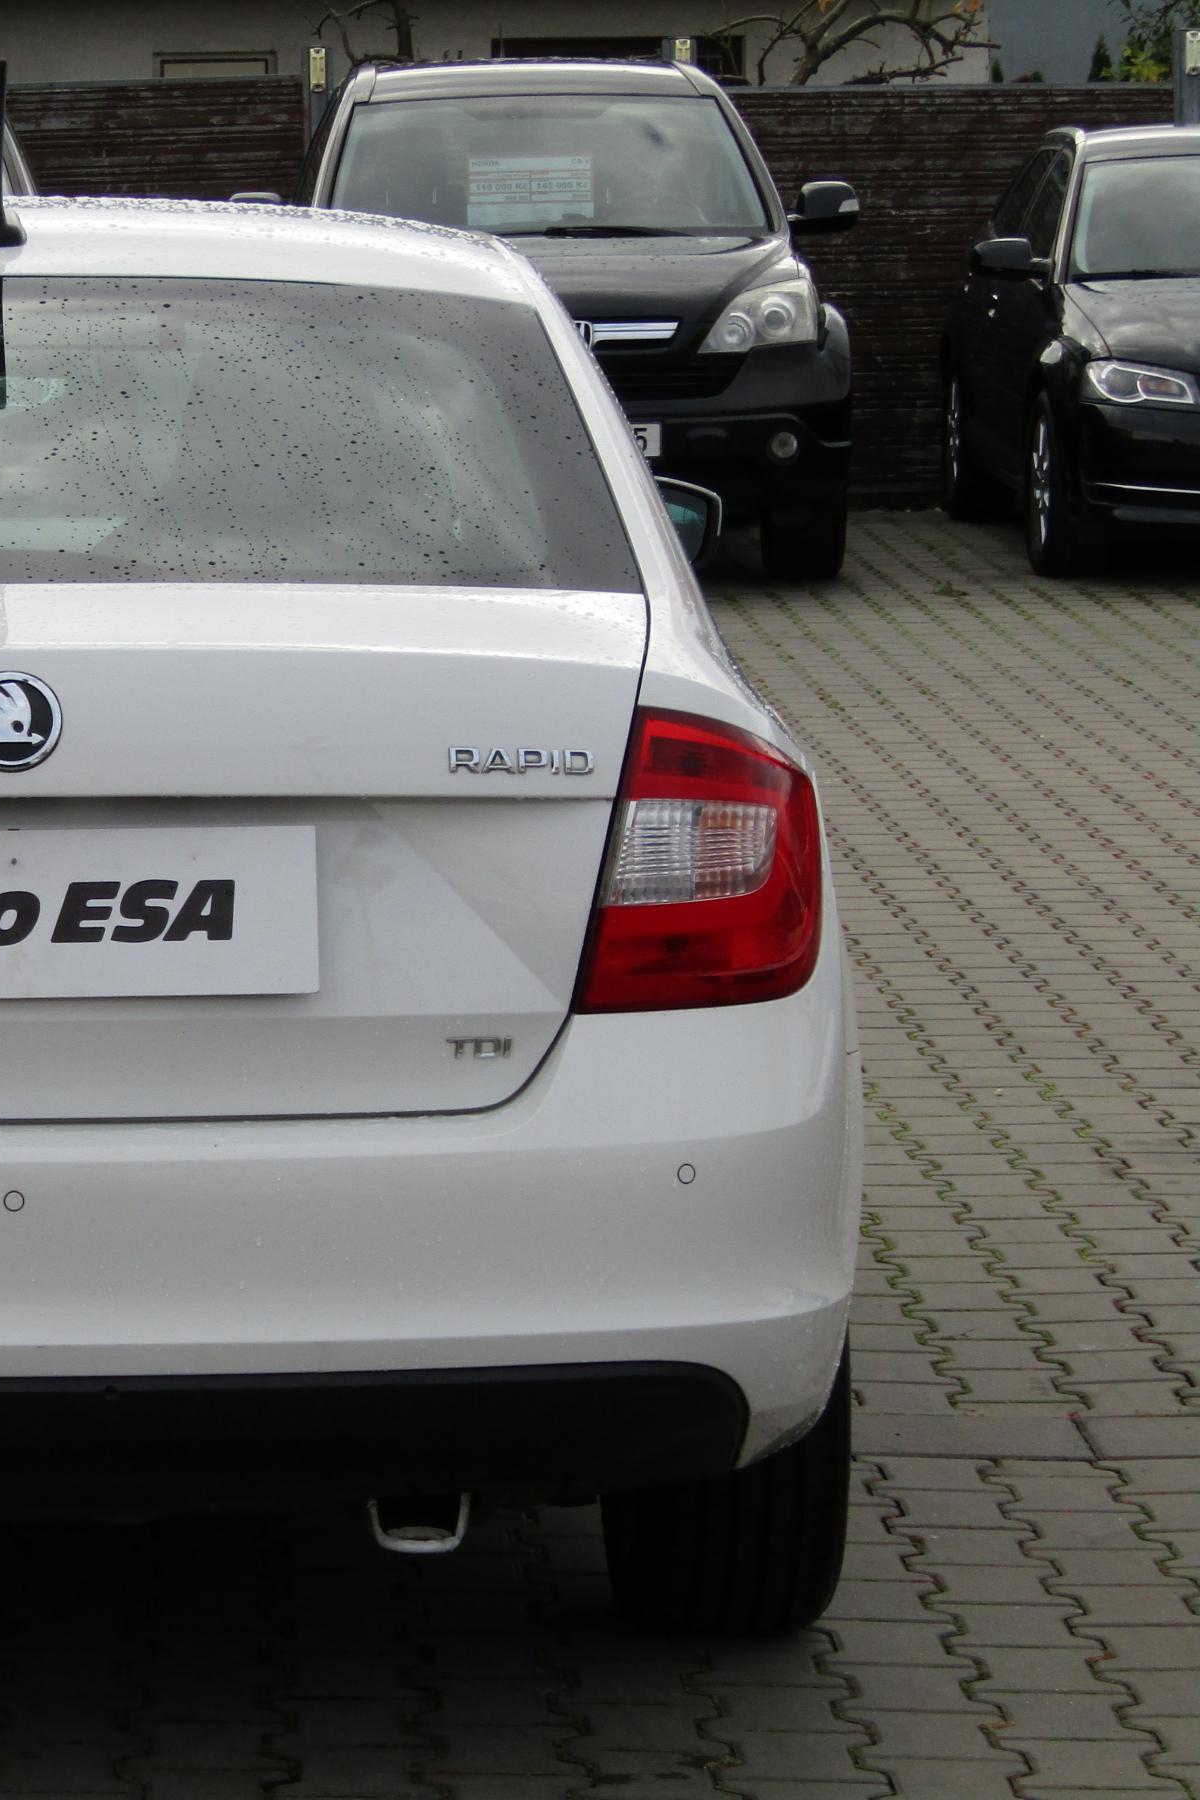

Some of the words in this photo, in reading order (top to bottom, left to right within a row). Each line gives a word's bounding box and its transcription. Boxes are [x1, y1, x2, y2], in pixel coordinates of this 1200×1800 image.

[448, 747, 594, 776] RAPID
[50, 879, 236, 943] ESA
[446, 1036, 513, 1058] TDI
